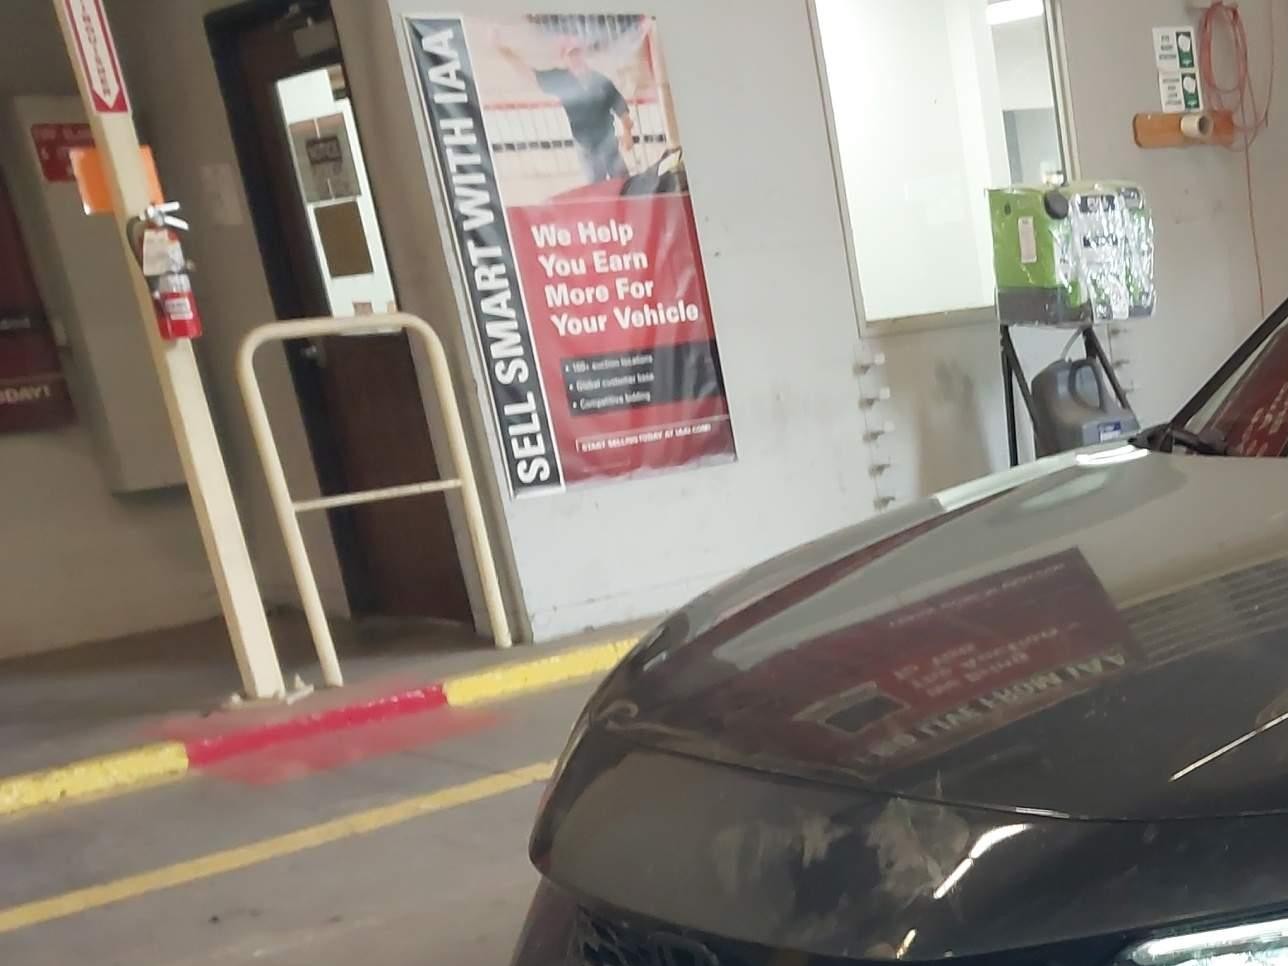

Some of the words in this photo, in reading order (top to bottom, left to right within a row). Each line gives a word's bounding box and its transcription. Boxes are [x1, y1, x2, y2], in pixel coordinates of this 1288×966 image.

[421, 28, 468, 104] IAA
[439, 117, 494, 231] WITH
[531, 224, 572, 248] We
[577, 218, 633, 246] Help
[538, 254, 587, 278] You
[592, 250, 648, 273] Earn
[467, 239, 529, 384] SMART
[544, 282, 609, 308] More
[615, 277, 654, 300] For
[550, 312, 607, 337] Your
[613, 299, 698, 330] Vehicle
[504, 390, 551, 485] SELL
[639, 430, 663, 443] TODAY
